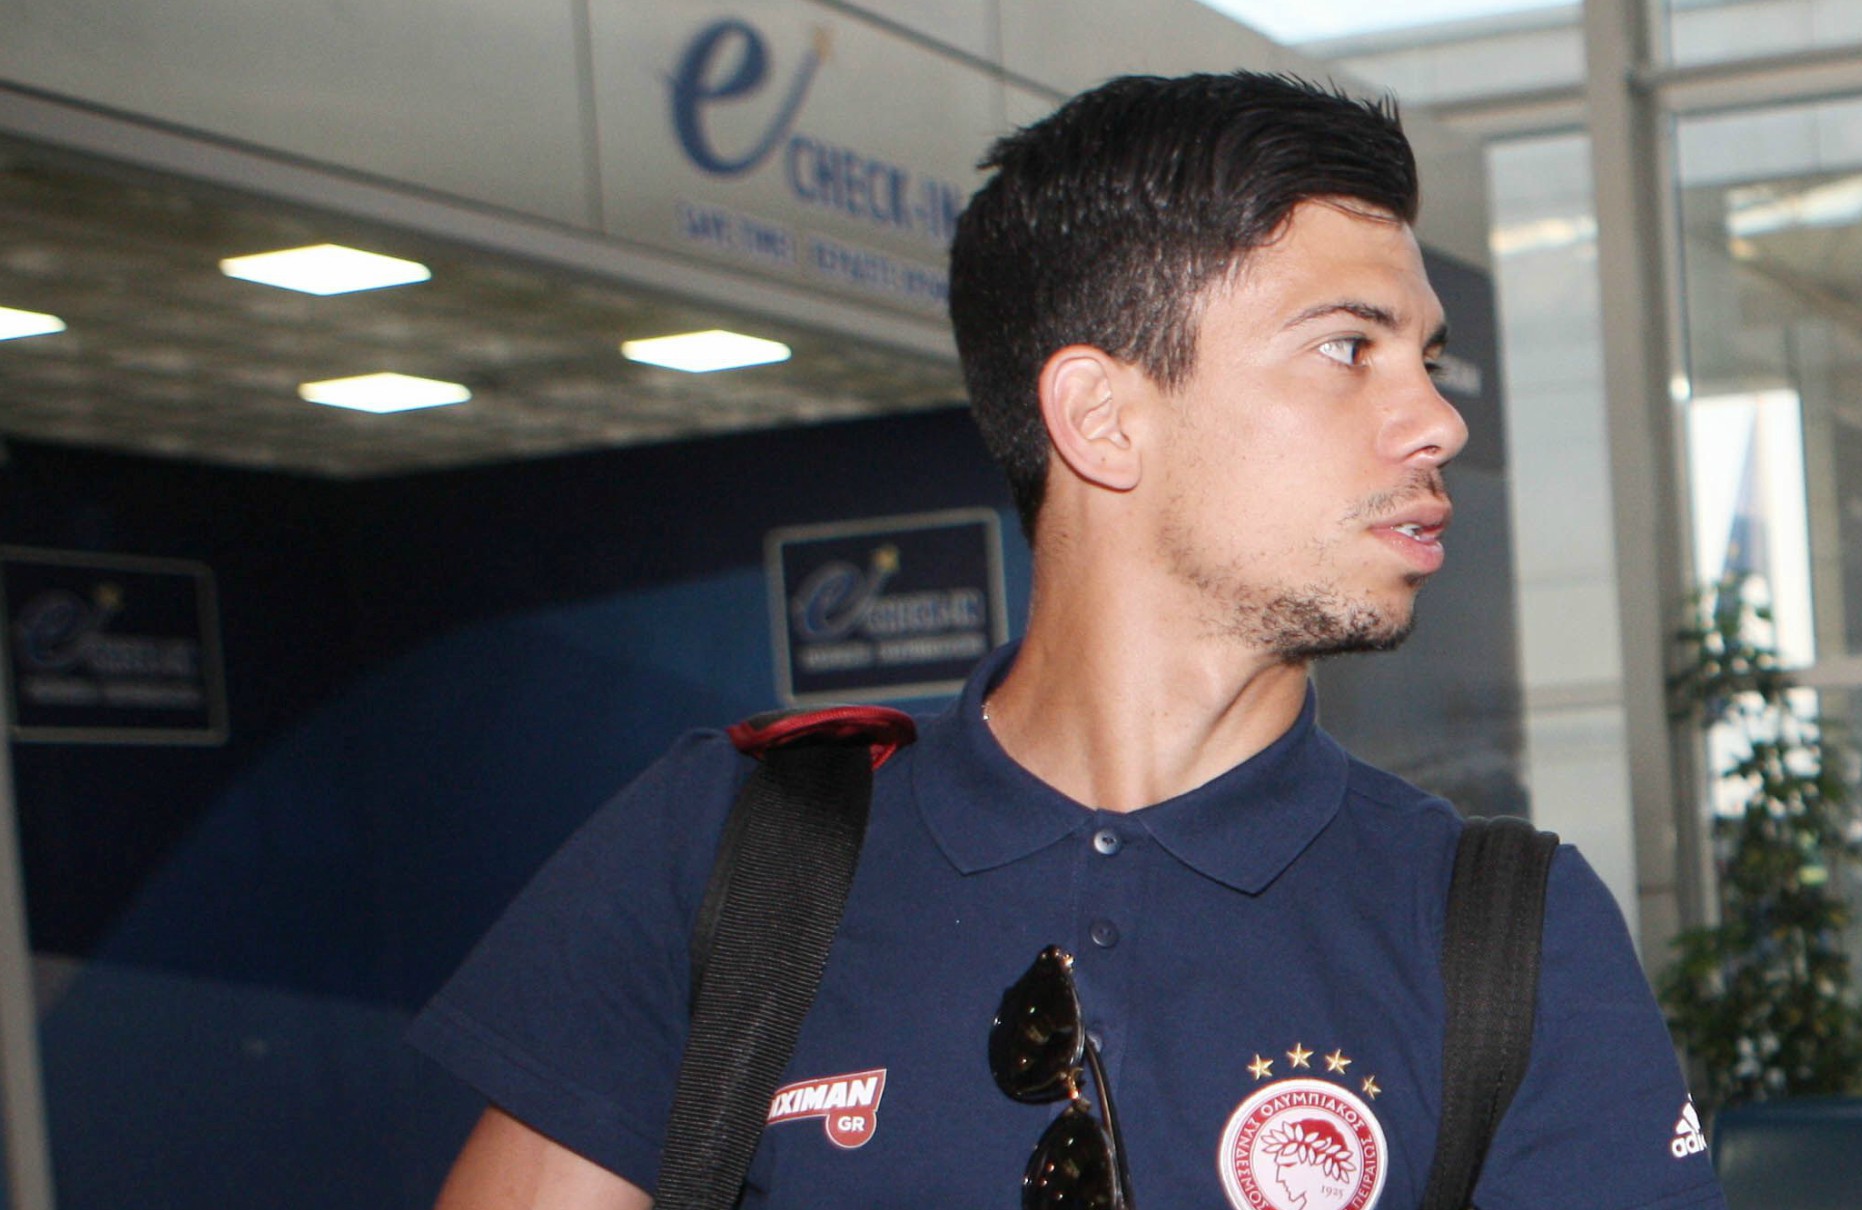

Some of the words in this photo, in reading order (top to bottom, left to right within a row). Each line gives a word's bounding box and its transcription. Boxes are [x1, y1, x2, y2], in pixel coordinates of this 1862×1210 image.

[837, 1116, 866, 1132] GR
[1260, 1092, 1365, 1132] ΟΛΥΜΠΙΑΚΟΣ
[1352, 1136, 1377, 1210] ΠΕΙΡΑΙΩΣ
[1320, 1184, 1345, 1199] 1925
